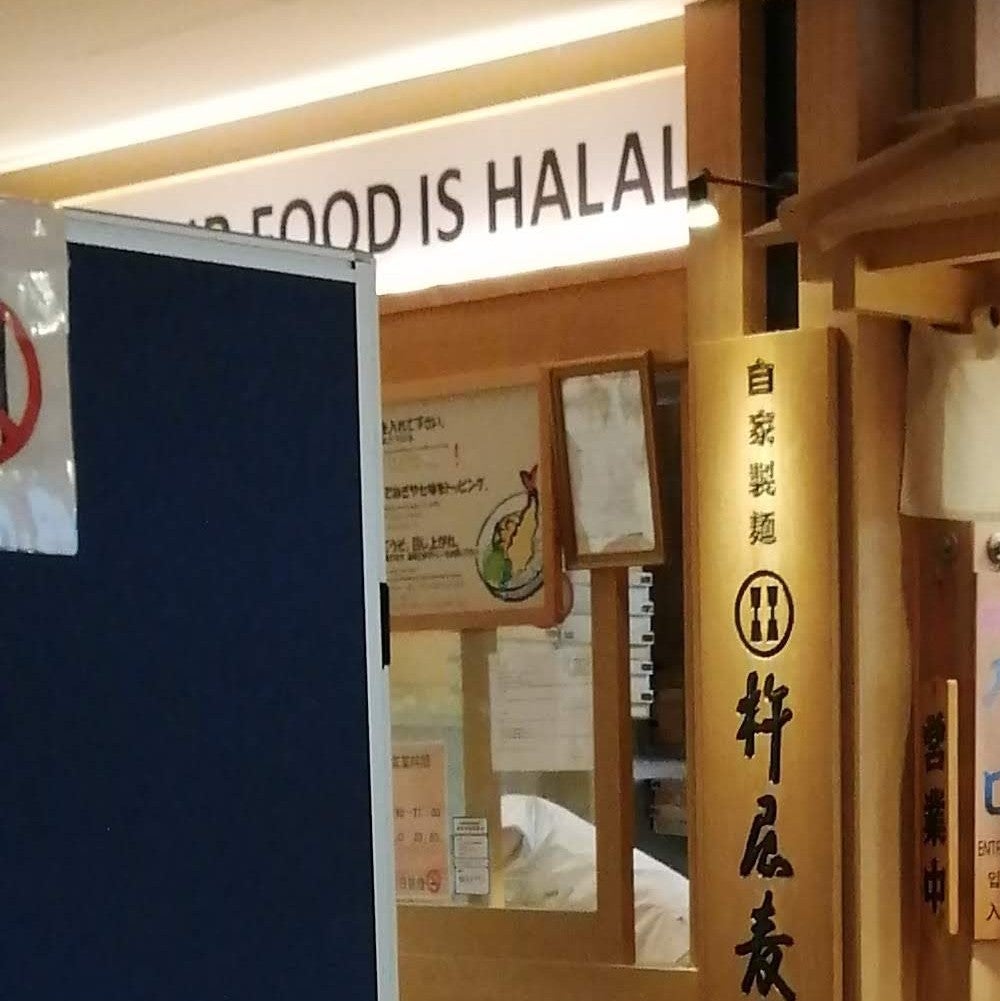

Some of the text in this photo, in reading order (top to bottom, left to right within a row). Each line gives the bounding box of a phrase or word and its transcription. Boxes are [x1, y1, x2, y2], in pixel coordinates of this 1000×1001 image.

[420, 168, 466, 246] IS
[486, 125, 688, 233] HALAL
[746, 357, 777, 546] 自家製麺
